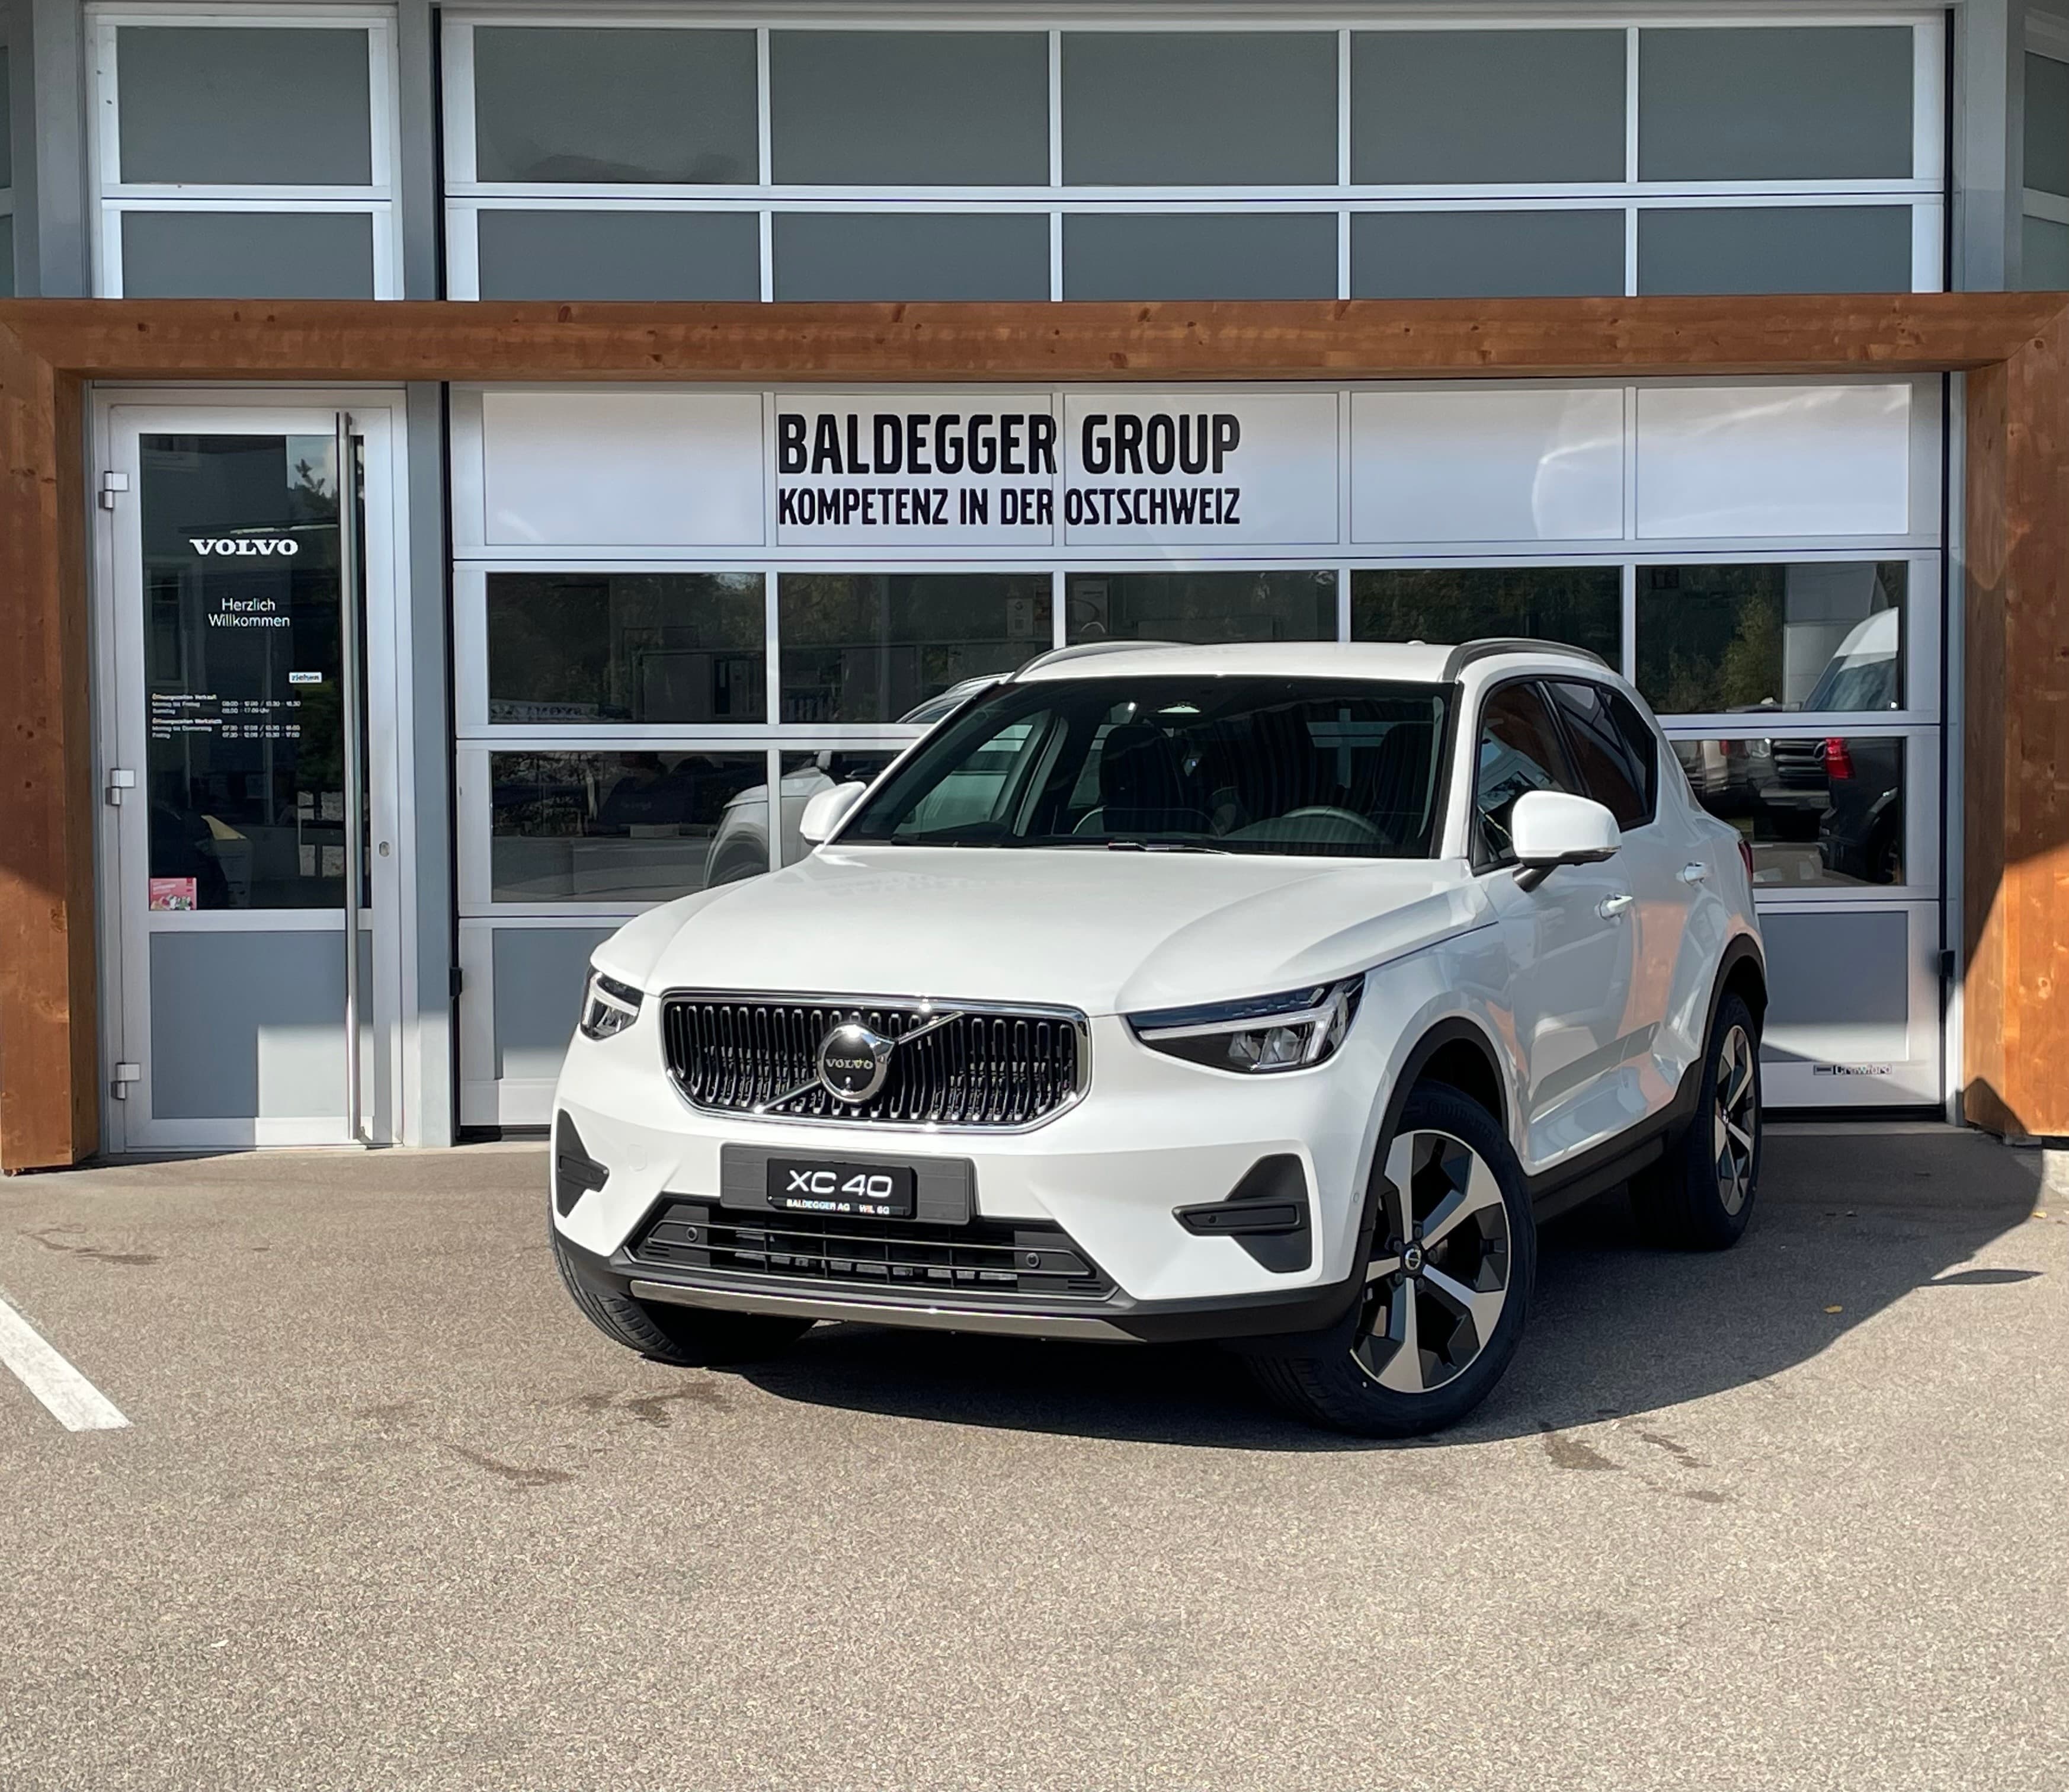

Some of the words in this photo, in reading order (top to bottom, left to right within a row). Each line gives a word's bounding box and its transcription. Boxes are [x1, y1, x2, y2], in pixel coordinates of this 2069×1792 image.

[778, 413, 1057, 475] BALDEGGER
[1081, 413, 1241, 475] GROUP
[778, 487, 949, 526] KOMPETENZ
[960, 487, 988, 526] IN
[1000, 487, 1053, 526] DER
[1065, 487, 1241, 526] OSTSCHWEIZ
[189, 539, 299, 555] VOLVO
[222, 597, 276, 612] Herzlich
[208, 613, 290, 628] Willkommen
[825, 1058, 874, 1070] VOLVO
[786, 1169, 838, 1194] XC
[841, 1174, 893, 1198] 40
[786, 1199, 836, 1211] BALDEGGER
[837, 1202, 851, 1212] AG
